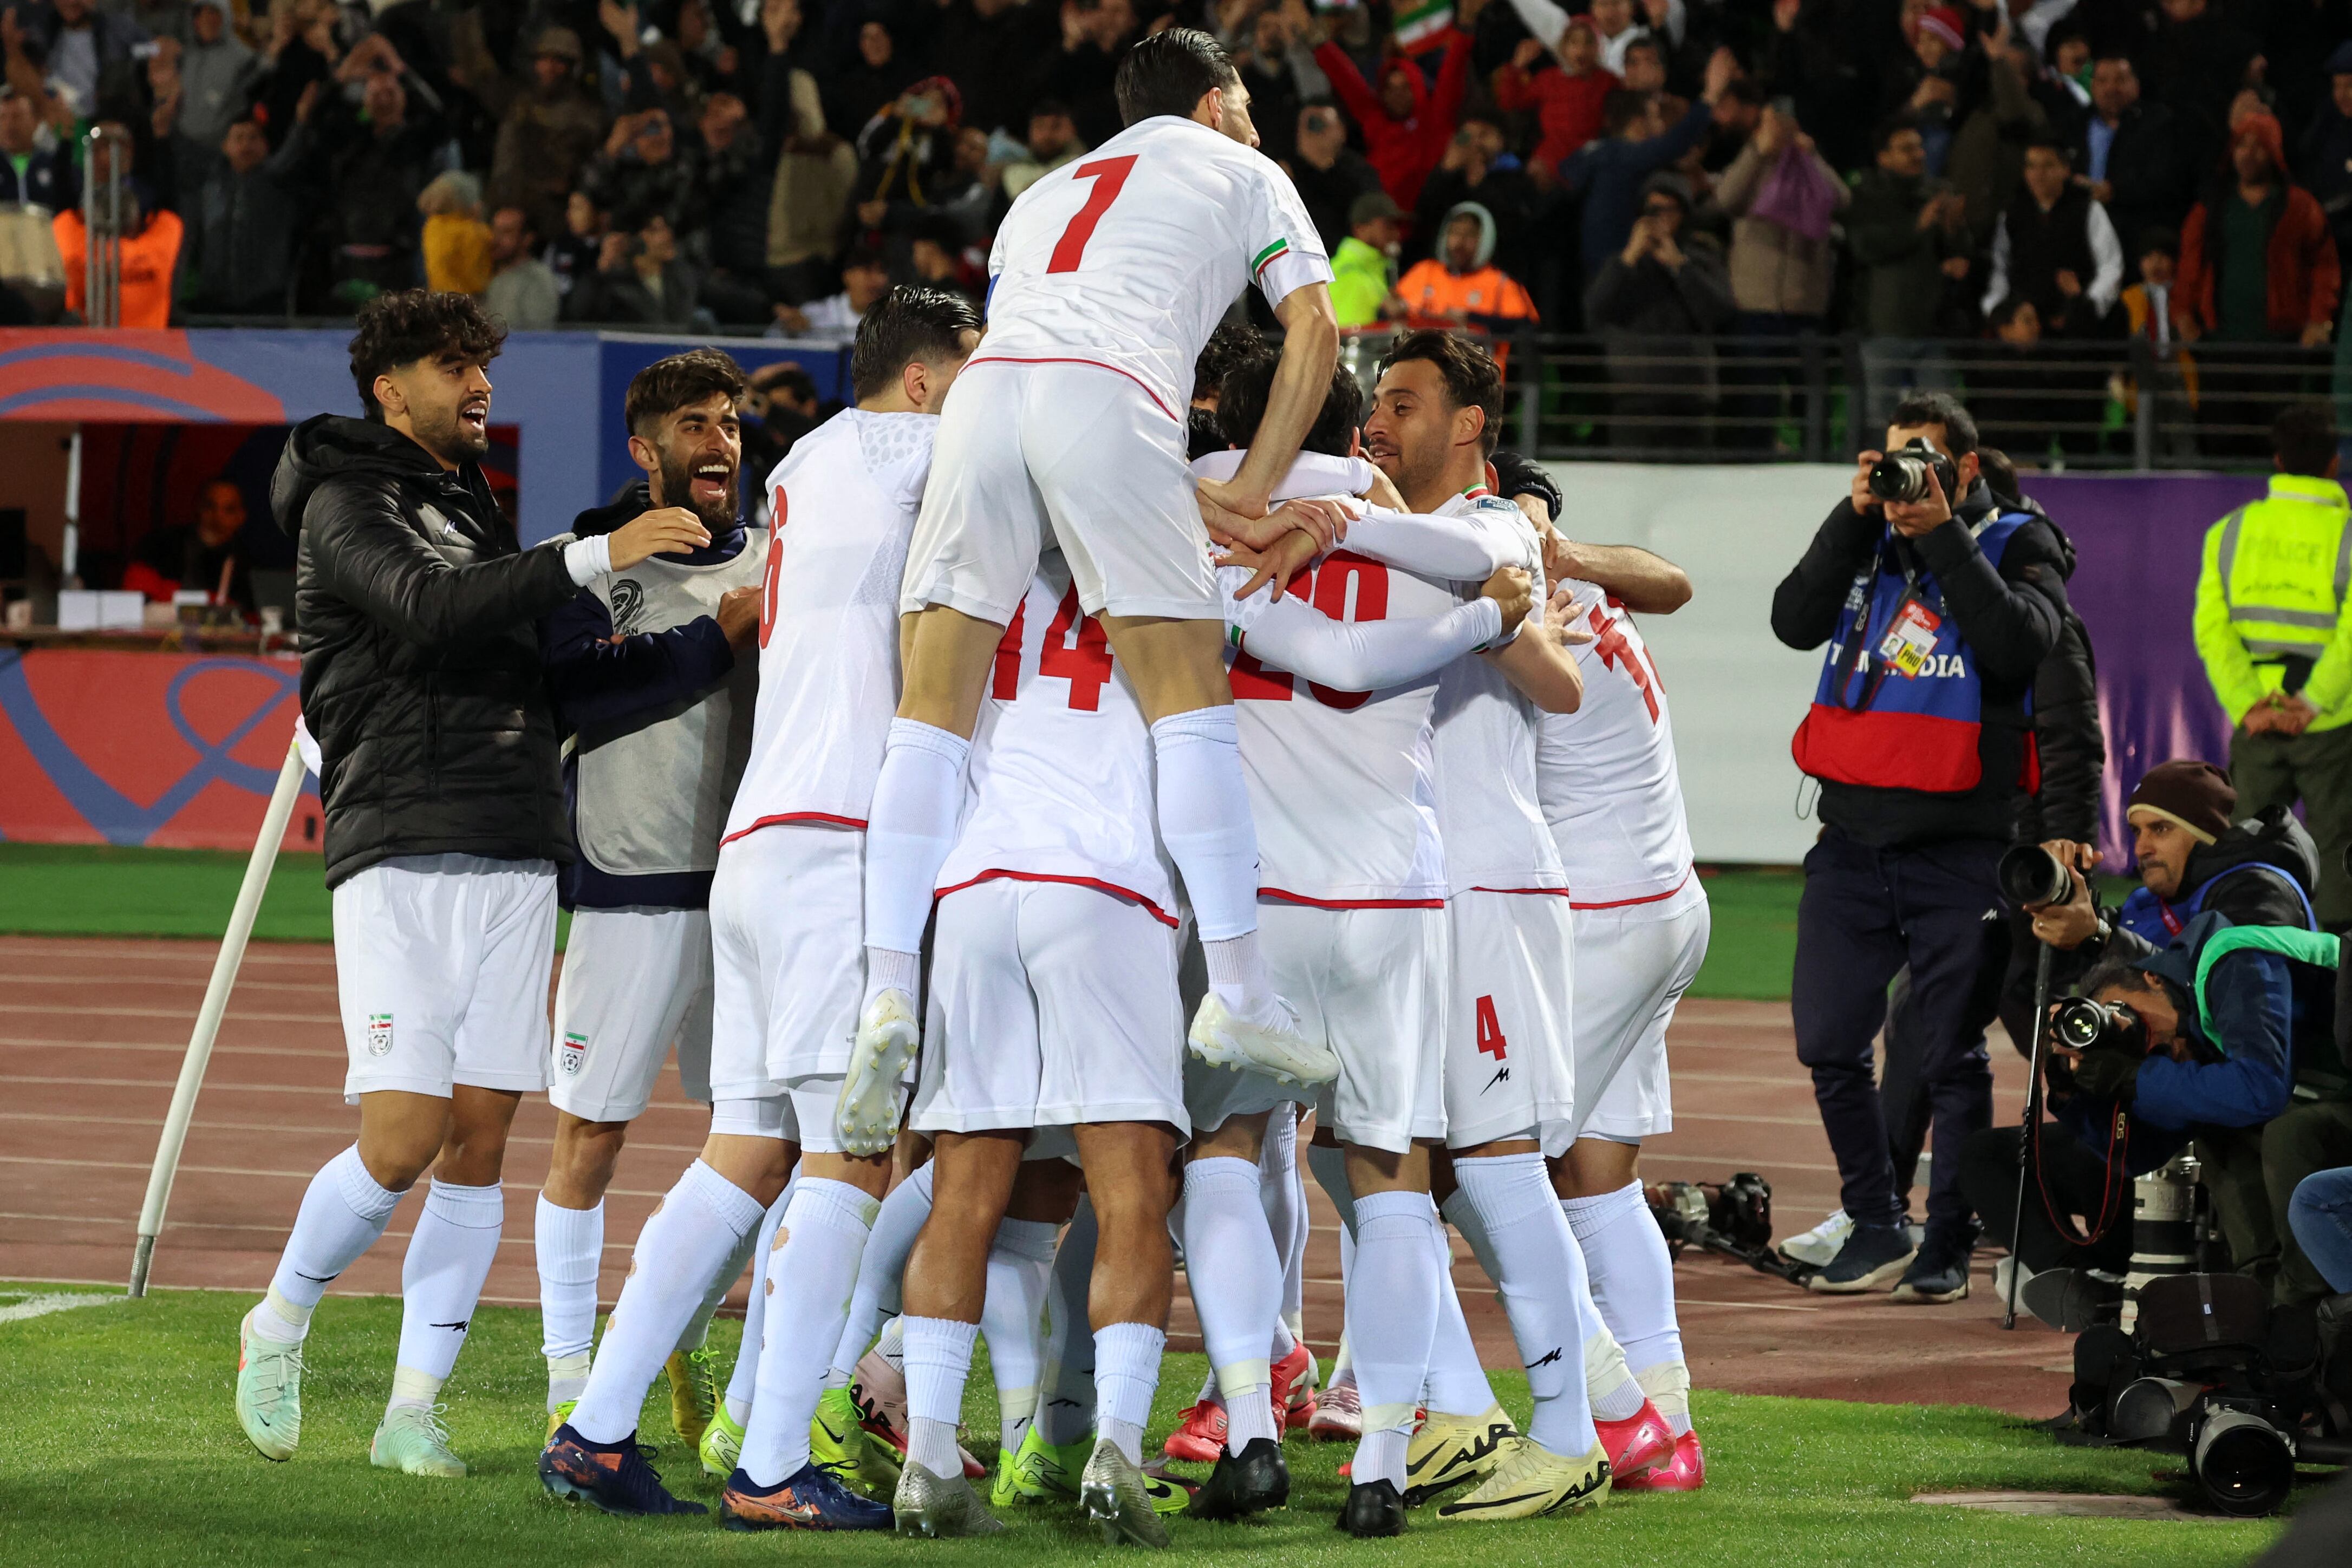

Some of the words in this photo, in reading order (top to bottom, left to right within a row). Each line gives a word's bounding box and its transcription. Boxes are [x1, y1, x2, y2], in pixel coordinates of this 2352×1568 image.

[1046, 154, 1140, 274] 7
[759, 485, 788, 650] 6
[992, 574, 1113, 712] 14
[1476, 994, 1507, 1061] 4
[2116, 1112, 2126, 1139] EOS
[1431, 1423, 1519, 1480] AIR
[1541, 1460, 1613, 1514] AIR
